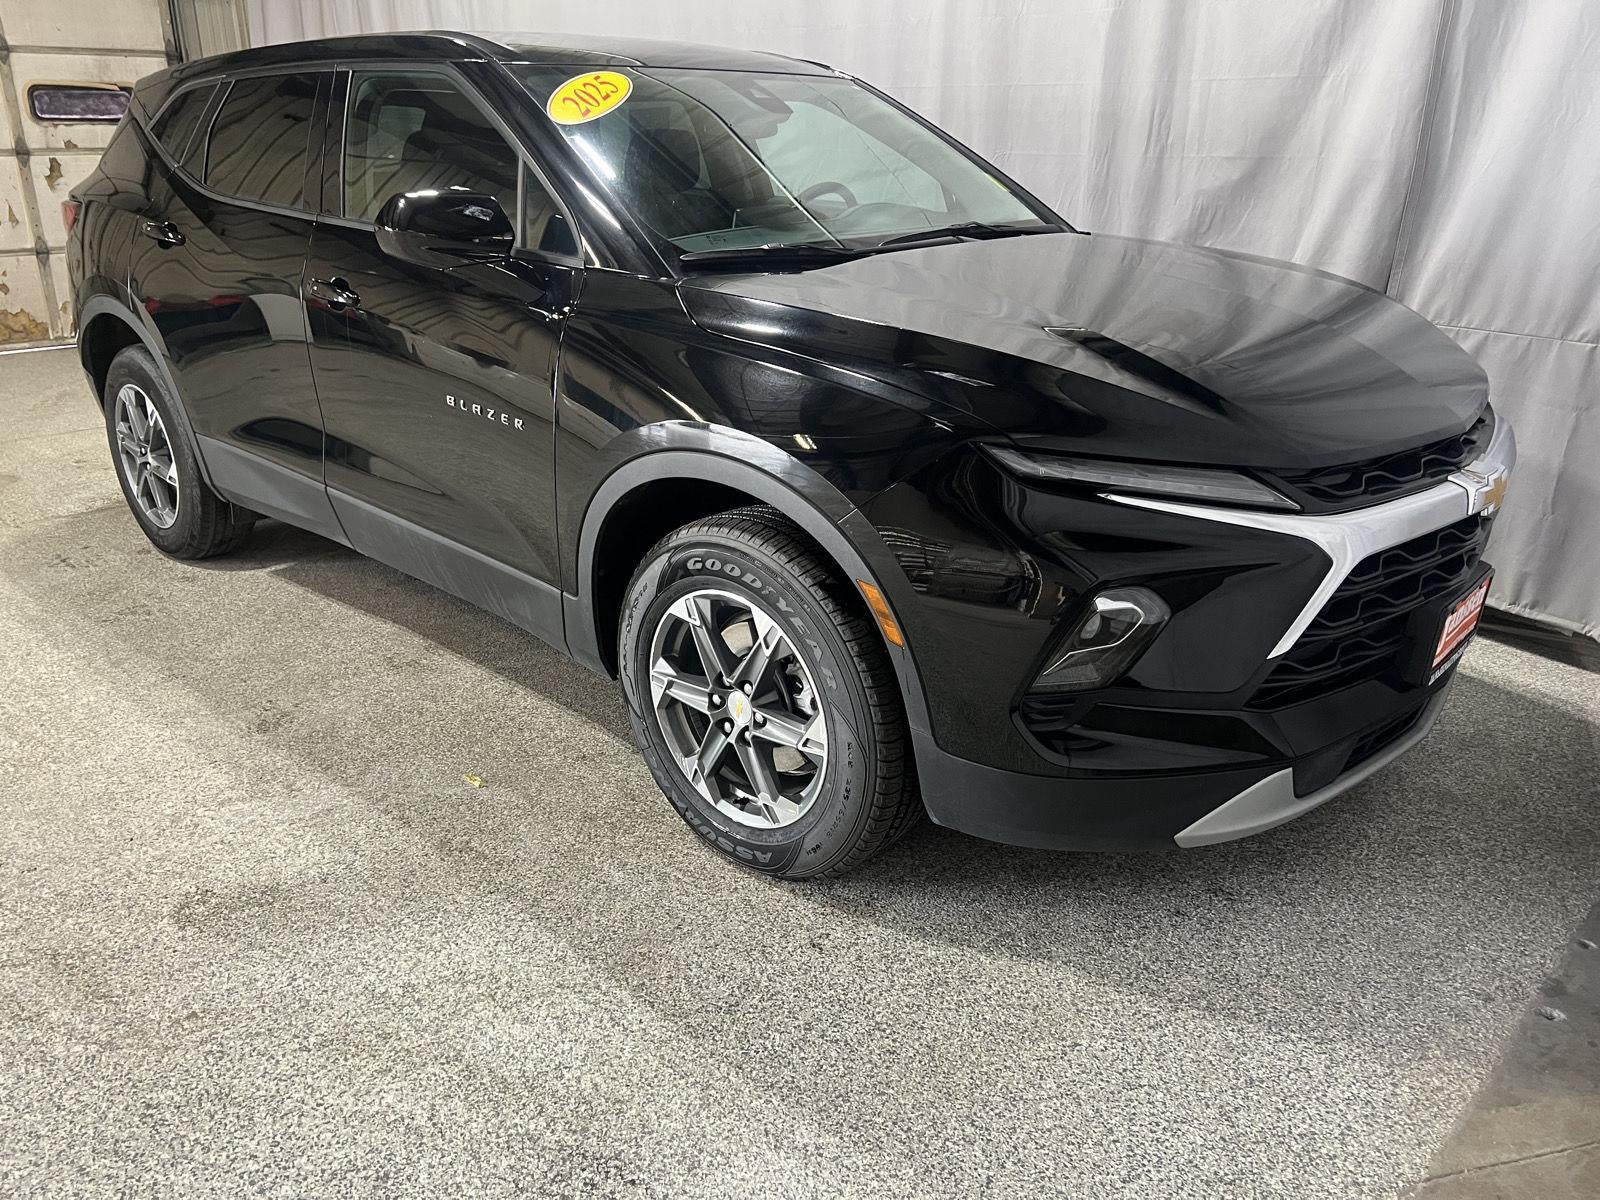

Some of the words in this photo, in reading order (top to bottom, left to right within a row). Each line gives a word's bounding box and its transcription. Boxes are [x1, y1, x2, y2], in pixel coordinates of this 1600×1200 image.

[563, 75, 619, 118] 2025
[446, 395, 525, 431] BLAZER
[686, 557, 838, 691] GOODYEAR
